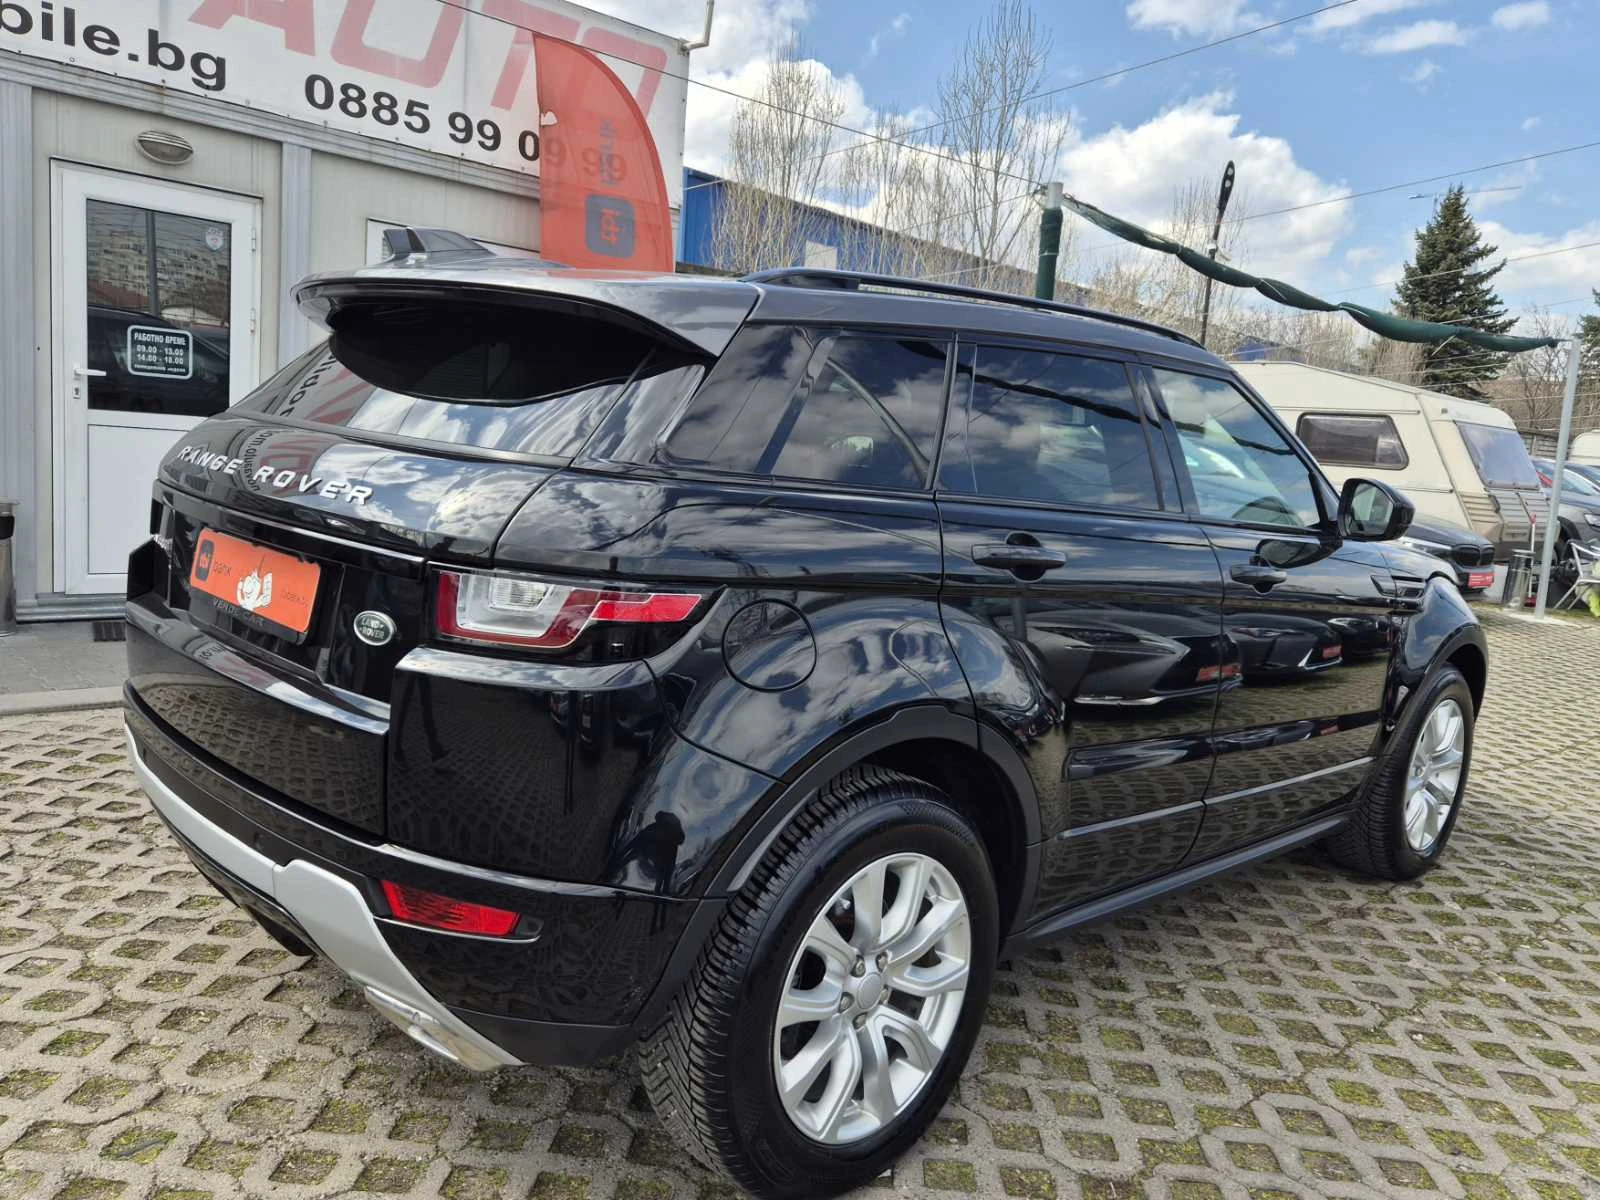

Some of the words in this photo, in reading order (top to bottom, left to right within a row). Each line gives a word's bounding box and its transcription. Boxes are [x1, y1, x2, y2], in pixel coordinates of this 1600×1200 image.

[304, 73, 431, 134] 0885
[448, 111, 501, 151] 99
[176, 445, 244, 475] RANGE
[252, 464, 374, 506] ROVER
